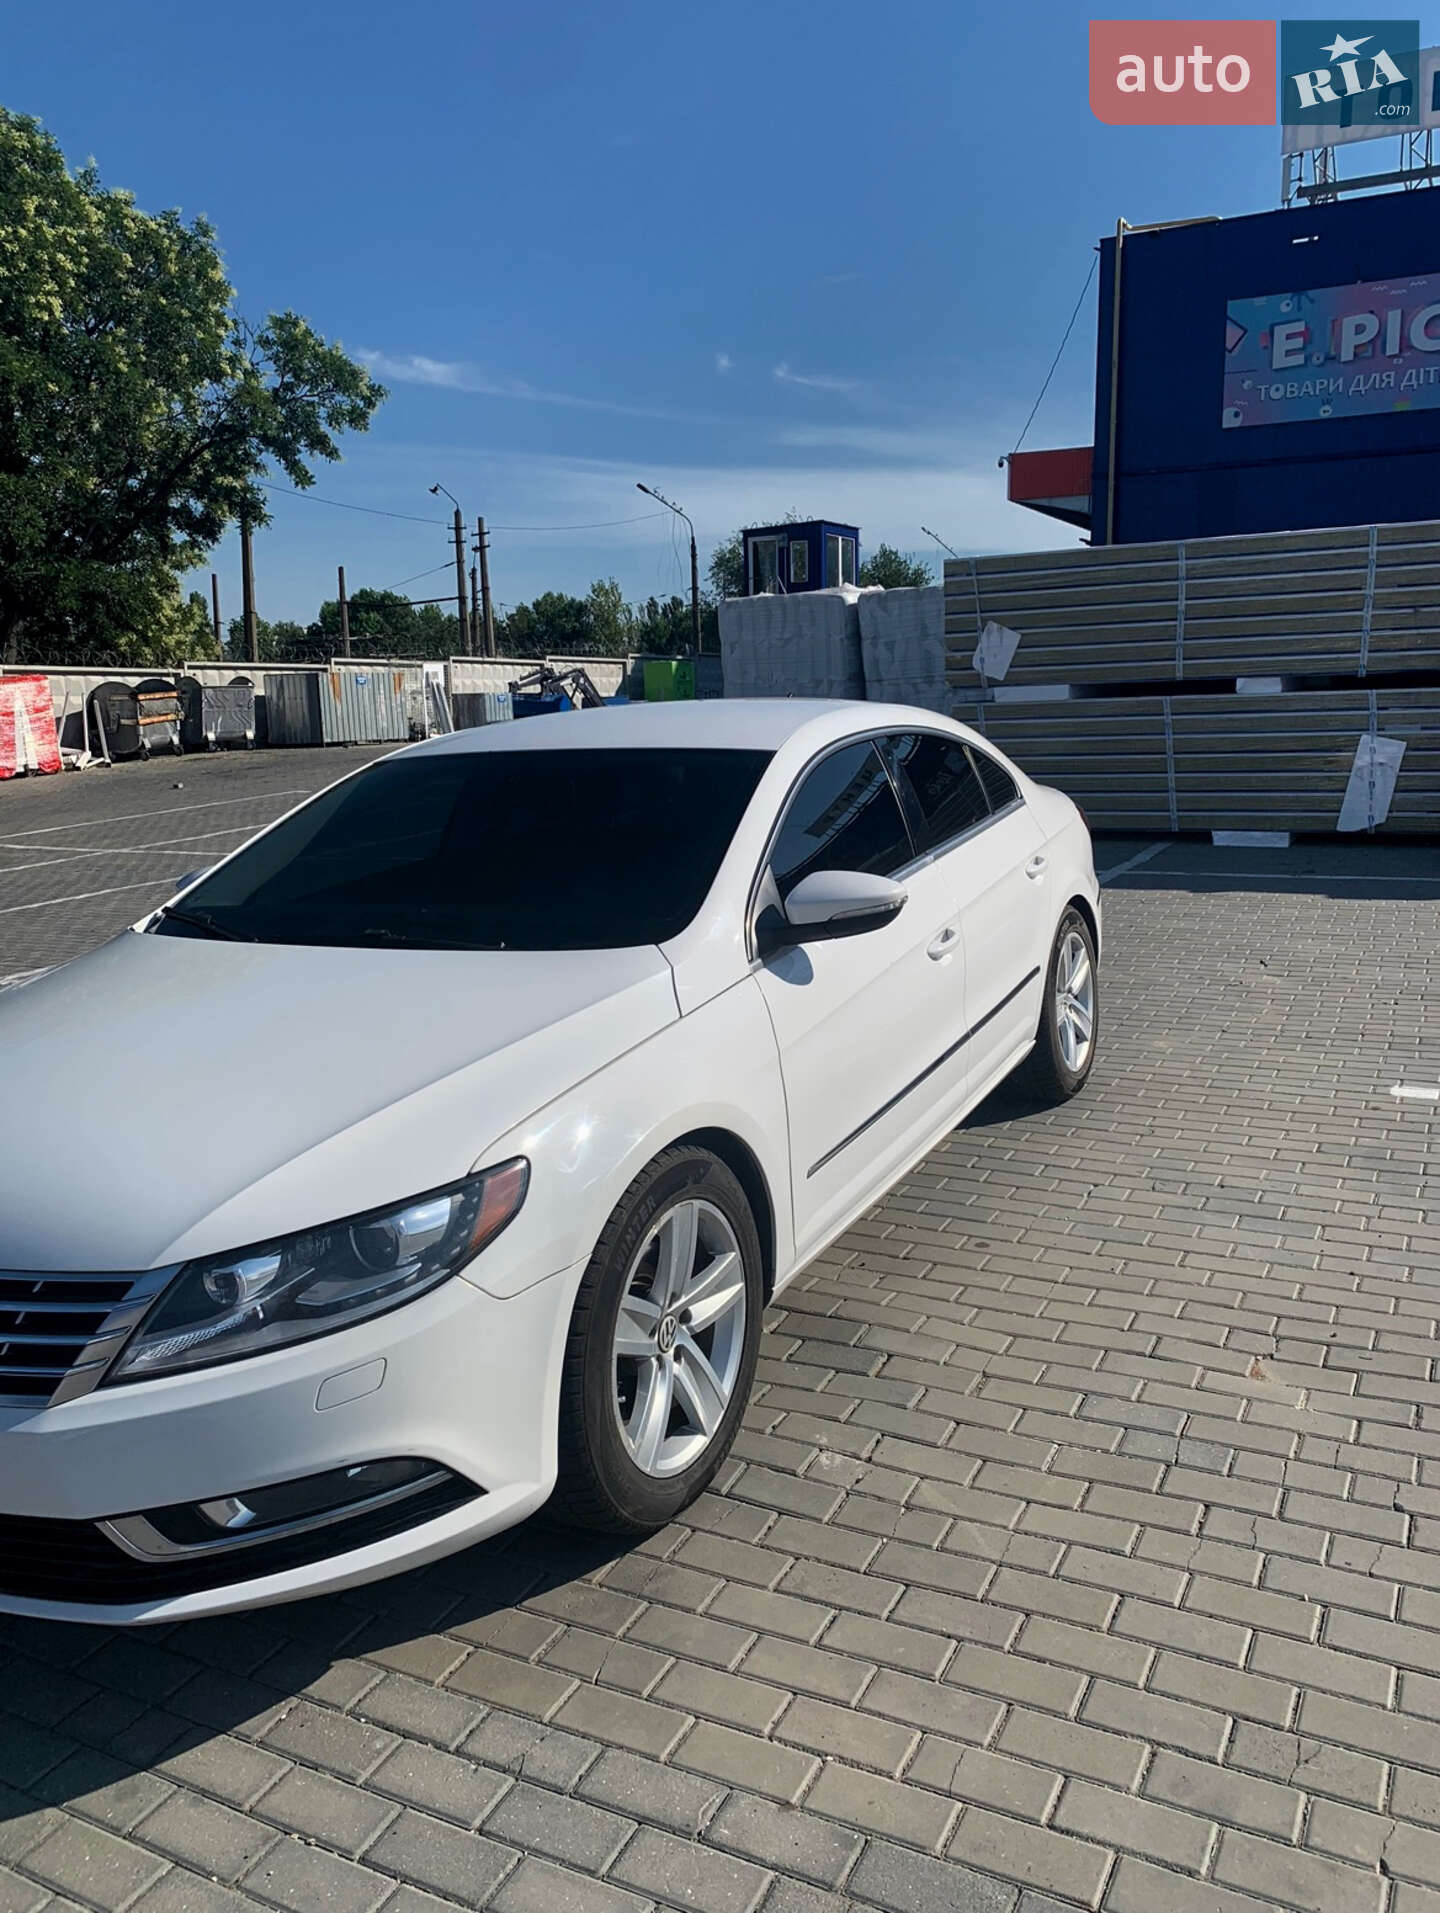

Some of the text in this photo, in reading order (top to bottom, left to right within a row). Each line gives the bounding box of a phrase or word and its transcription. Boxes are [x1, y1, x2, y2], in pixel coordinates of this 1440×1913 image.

[1257, 377, 1343, 400] ТОВАРИ
[1348, 371, 1396, 396] ДЛЯ
[615, 1196, 656, 1273] WINTER
